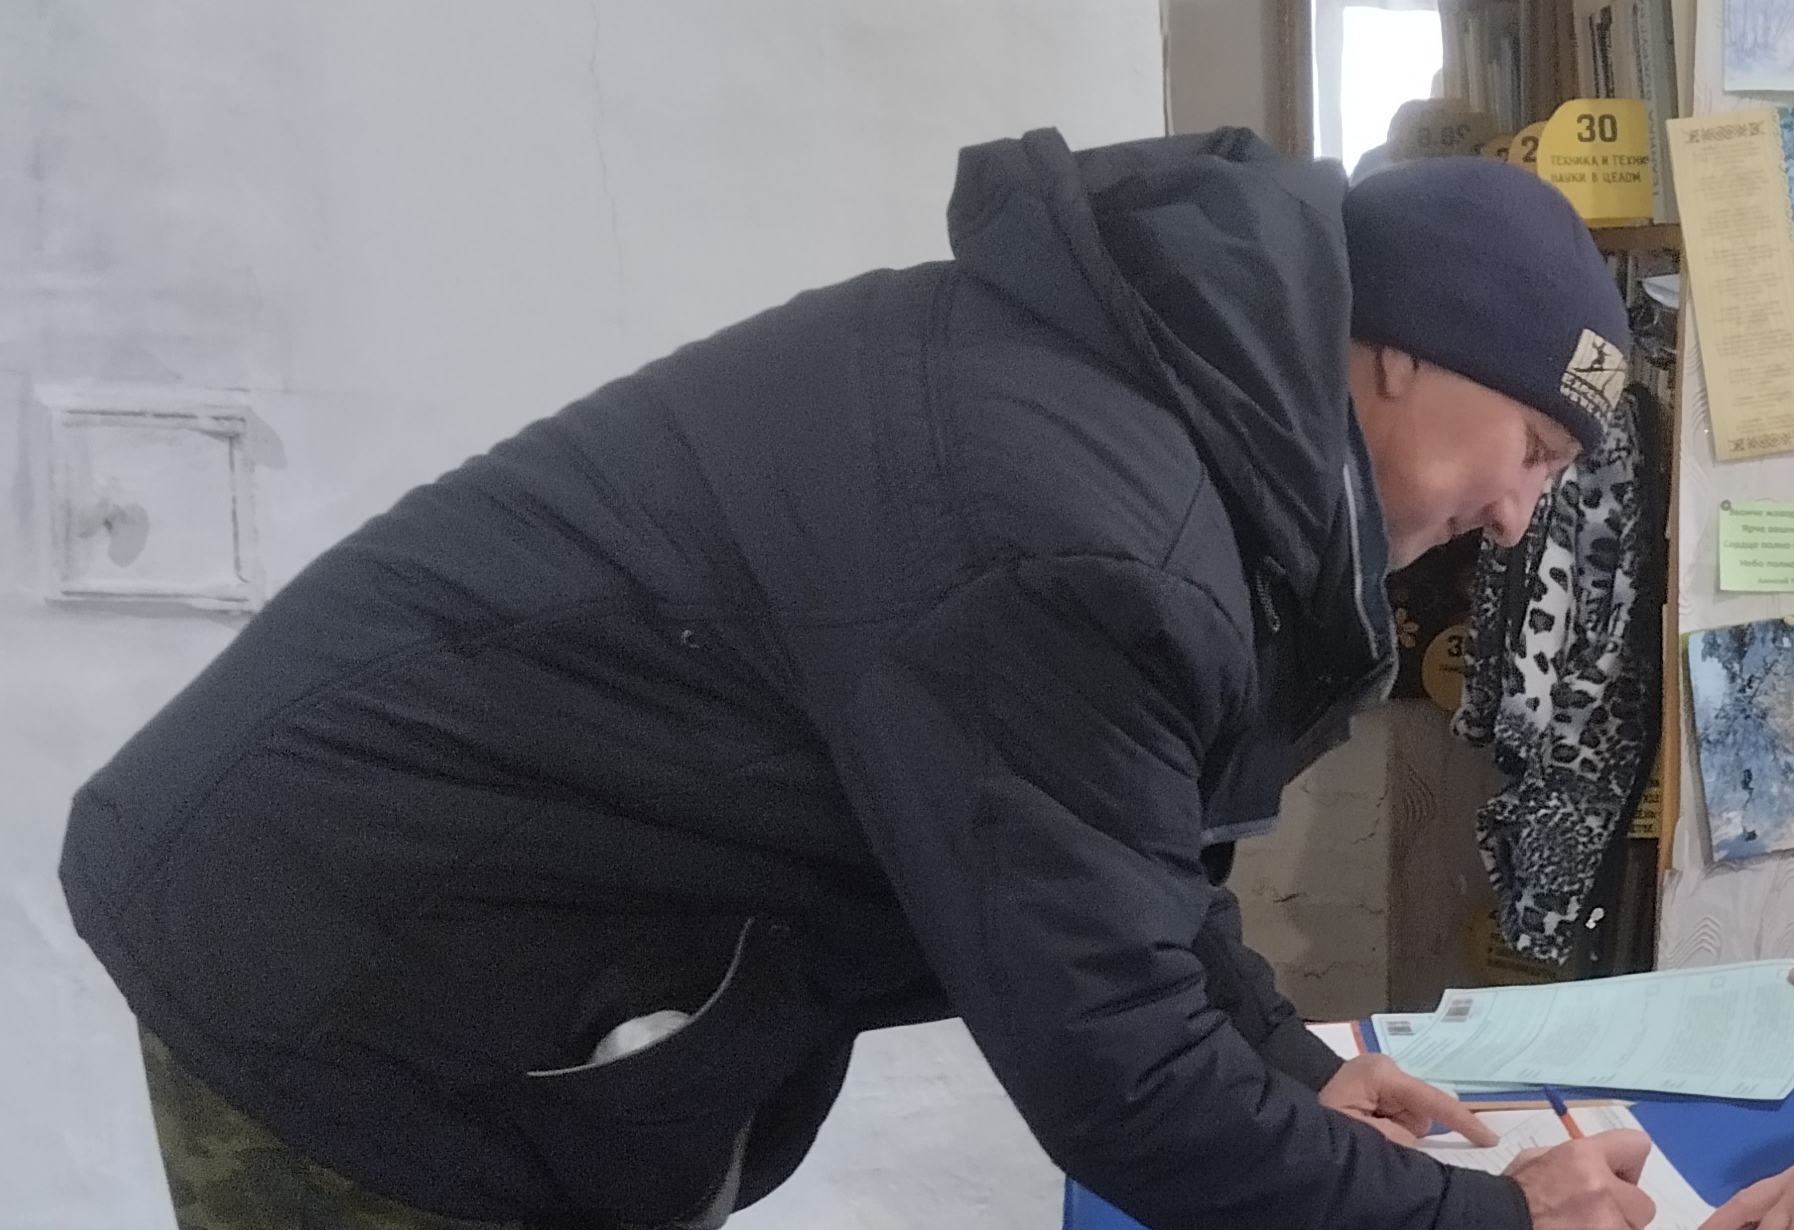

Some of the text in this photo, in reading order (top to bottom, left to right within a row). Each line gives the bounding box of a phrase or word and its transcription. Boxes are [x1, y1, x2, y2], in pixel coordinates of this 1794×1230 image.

[1576, 113, 1618, 143] 30
[1550, 155, 1599, 166] ТЕХНИКА
[1601, 155, 1610, 166] И
[1550, 170, 1642, 184] НАУКИ В ЦЕЛОМ
